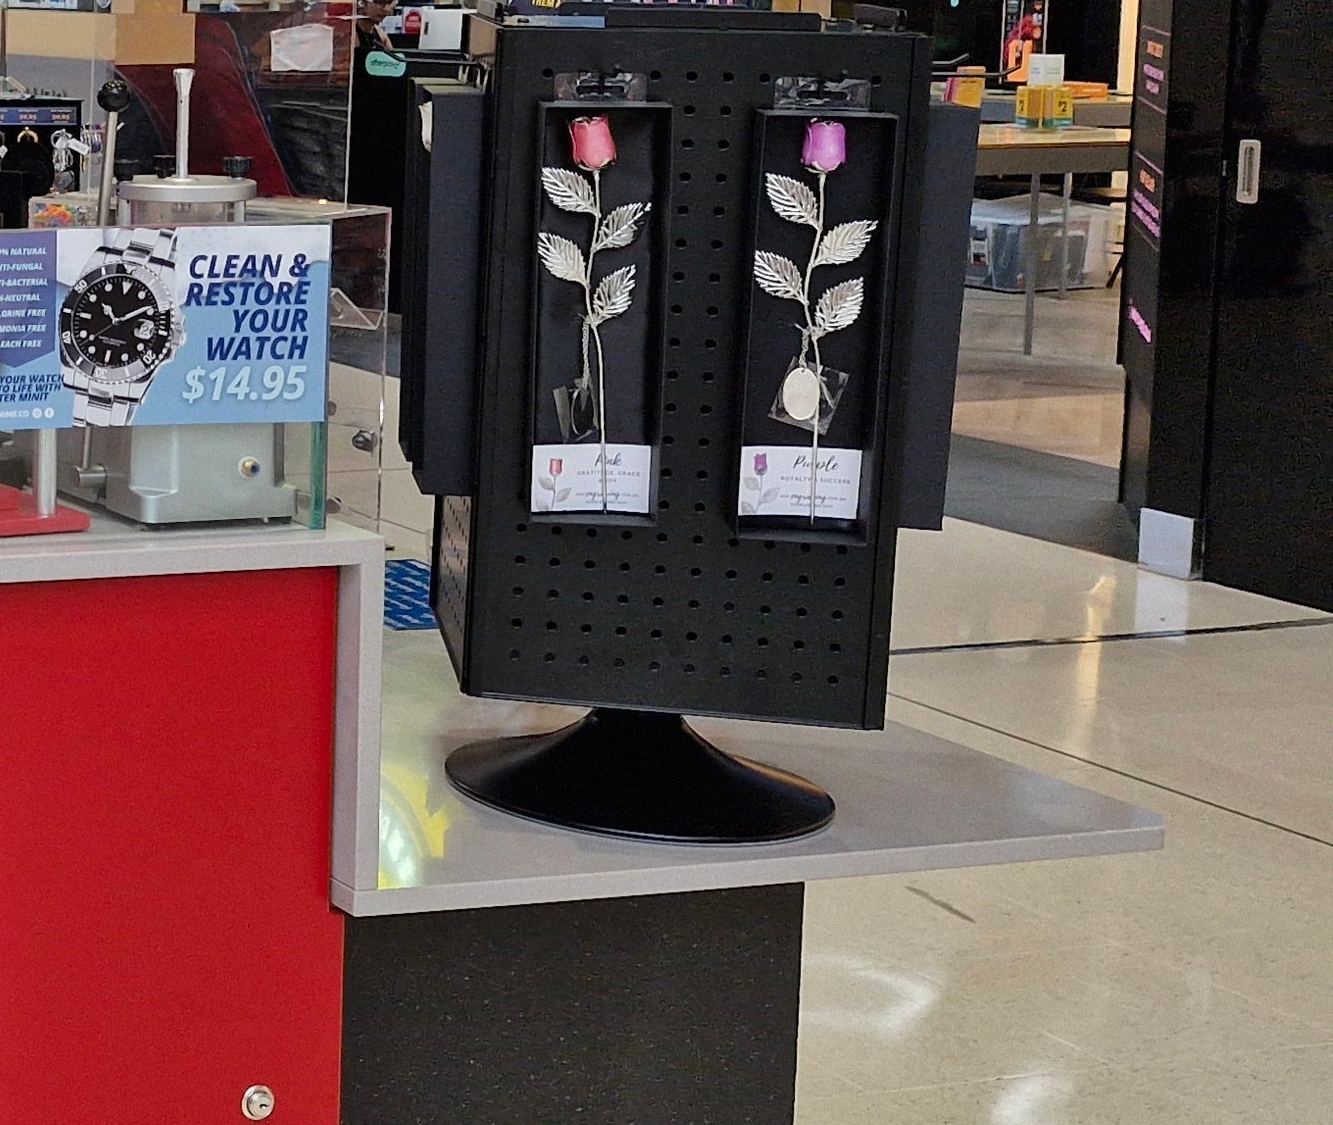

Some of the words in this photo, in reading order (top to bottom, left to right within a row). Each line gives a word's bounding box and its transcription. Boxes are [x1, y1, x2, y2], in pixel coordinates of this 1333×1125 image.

[10, 247, 47, 256] NATURAL
[188, 253, 273, 280] CLEAN
[288, 252, 311, 278] &
[185, 281, 311, 307] RESTORE
[27, 308, 47, 317] FREE
[233, 308, 309, 334] YOUR
[27, 324, 47, 332] FREE
[22, 339, 43, 348] FREE
[206, 335, 308, 361] WATCH
[0, 374, 27, 385] YOUR
[28, 373, 65, 384] WATCH
[181, 364, 307, 404] $14.95
[12, 383, 32, 393] LIFE
[35, 382, 62, 392] WITH
[18, 392, 50, 402] MINIT
[793, 454, 841, 473] Puple
